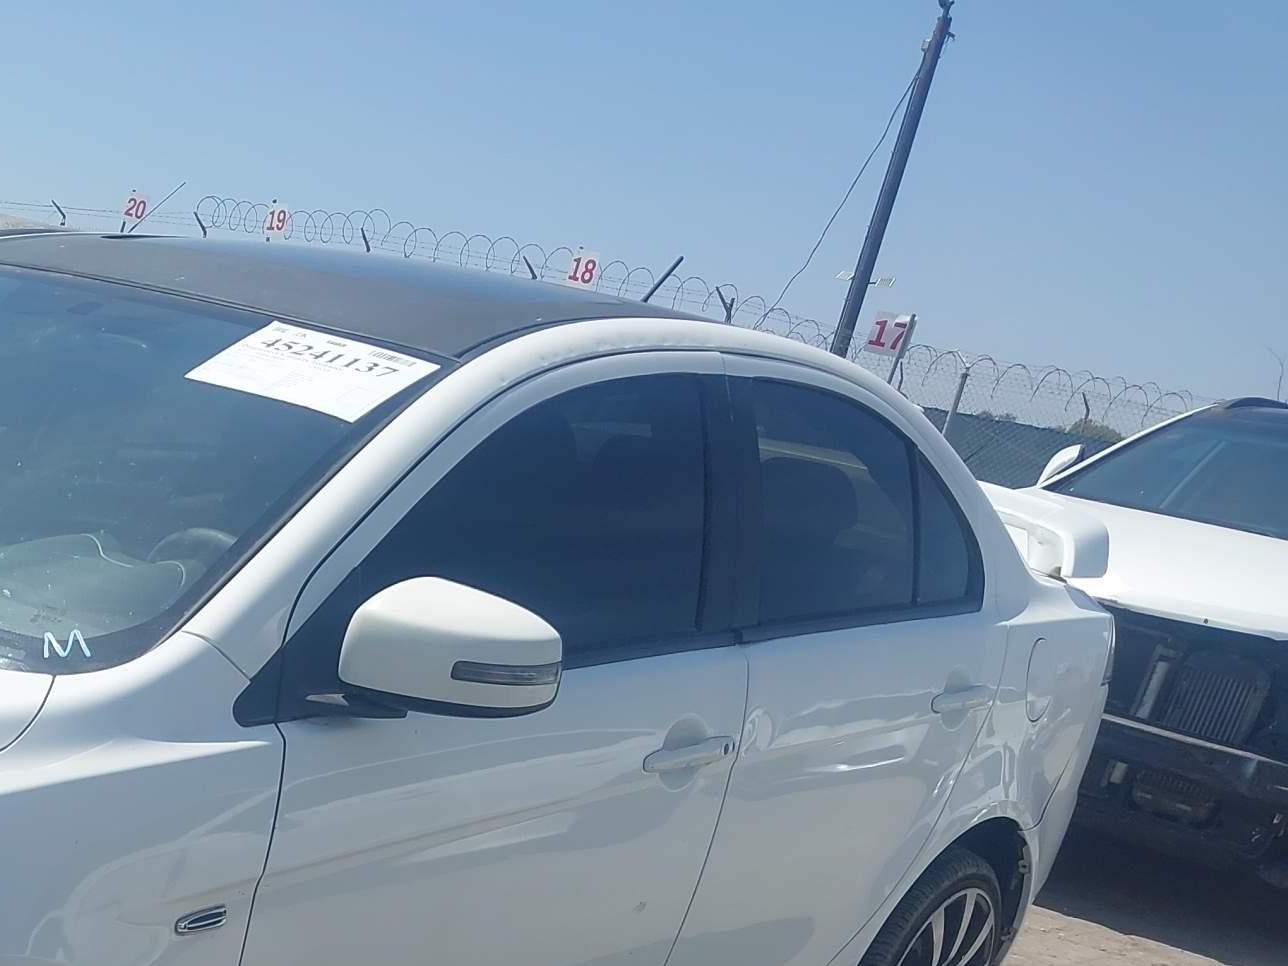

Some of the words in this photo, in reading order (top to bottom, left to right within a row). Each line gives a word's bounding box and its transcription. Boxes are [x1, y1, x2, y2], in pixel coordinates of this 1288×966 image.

[124, 197, 147, 219] 20
[266, 209, 287, 231] 19
[567, 256, 597, 284] 18
[867, 319, 908, 351] 17
[261, 338, 400, 377] 45241137
[43, 628, 92, 659] M
